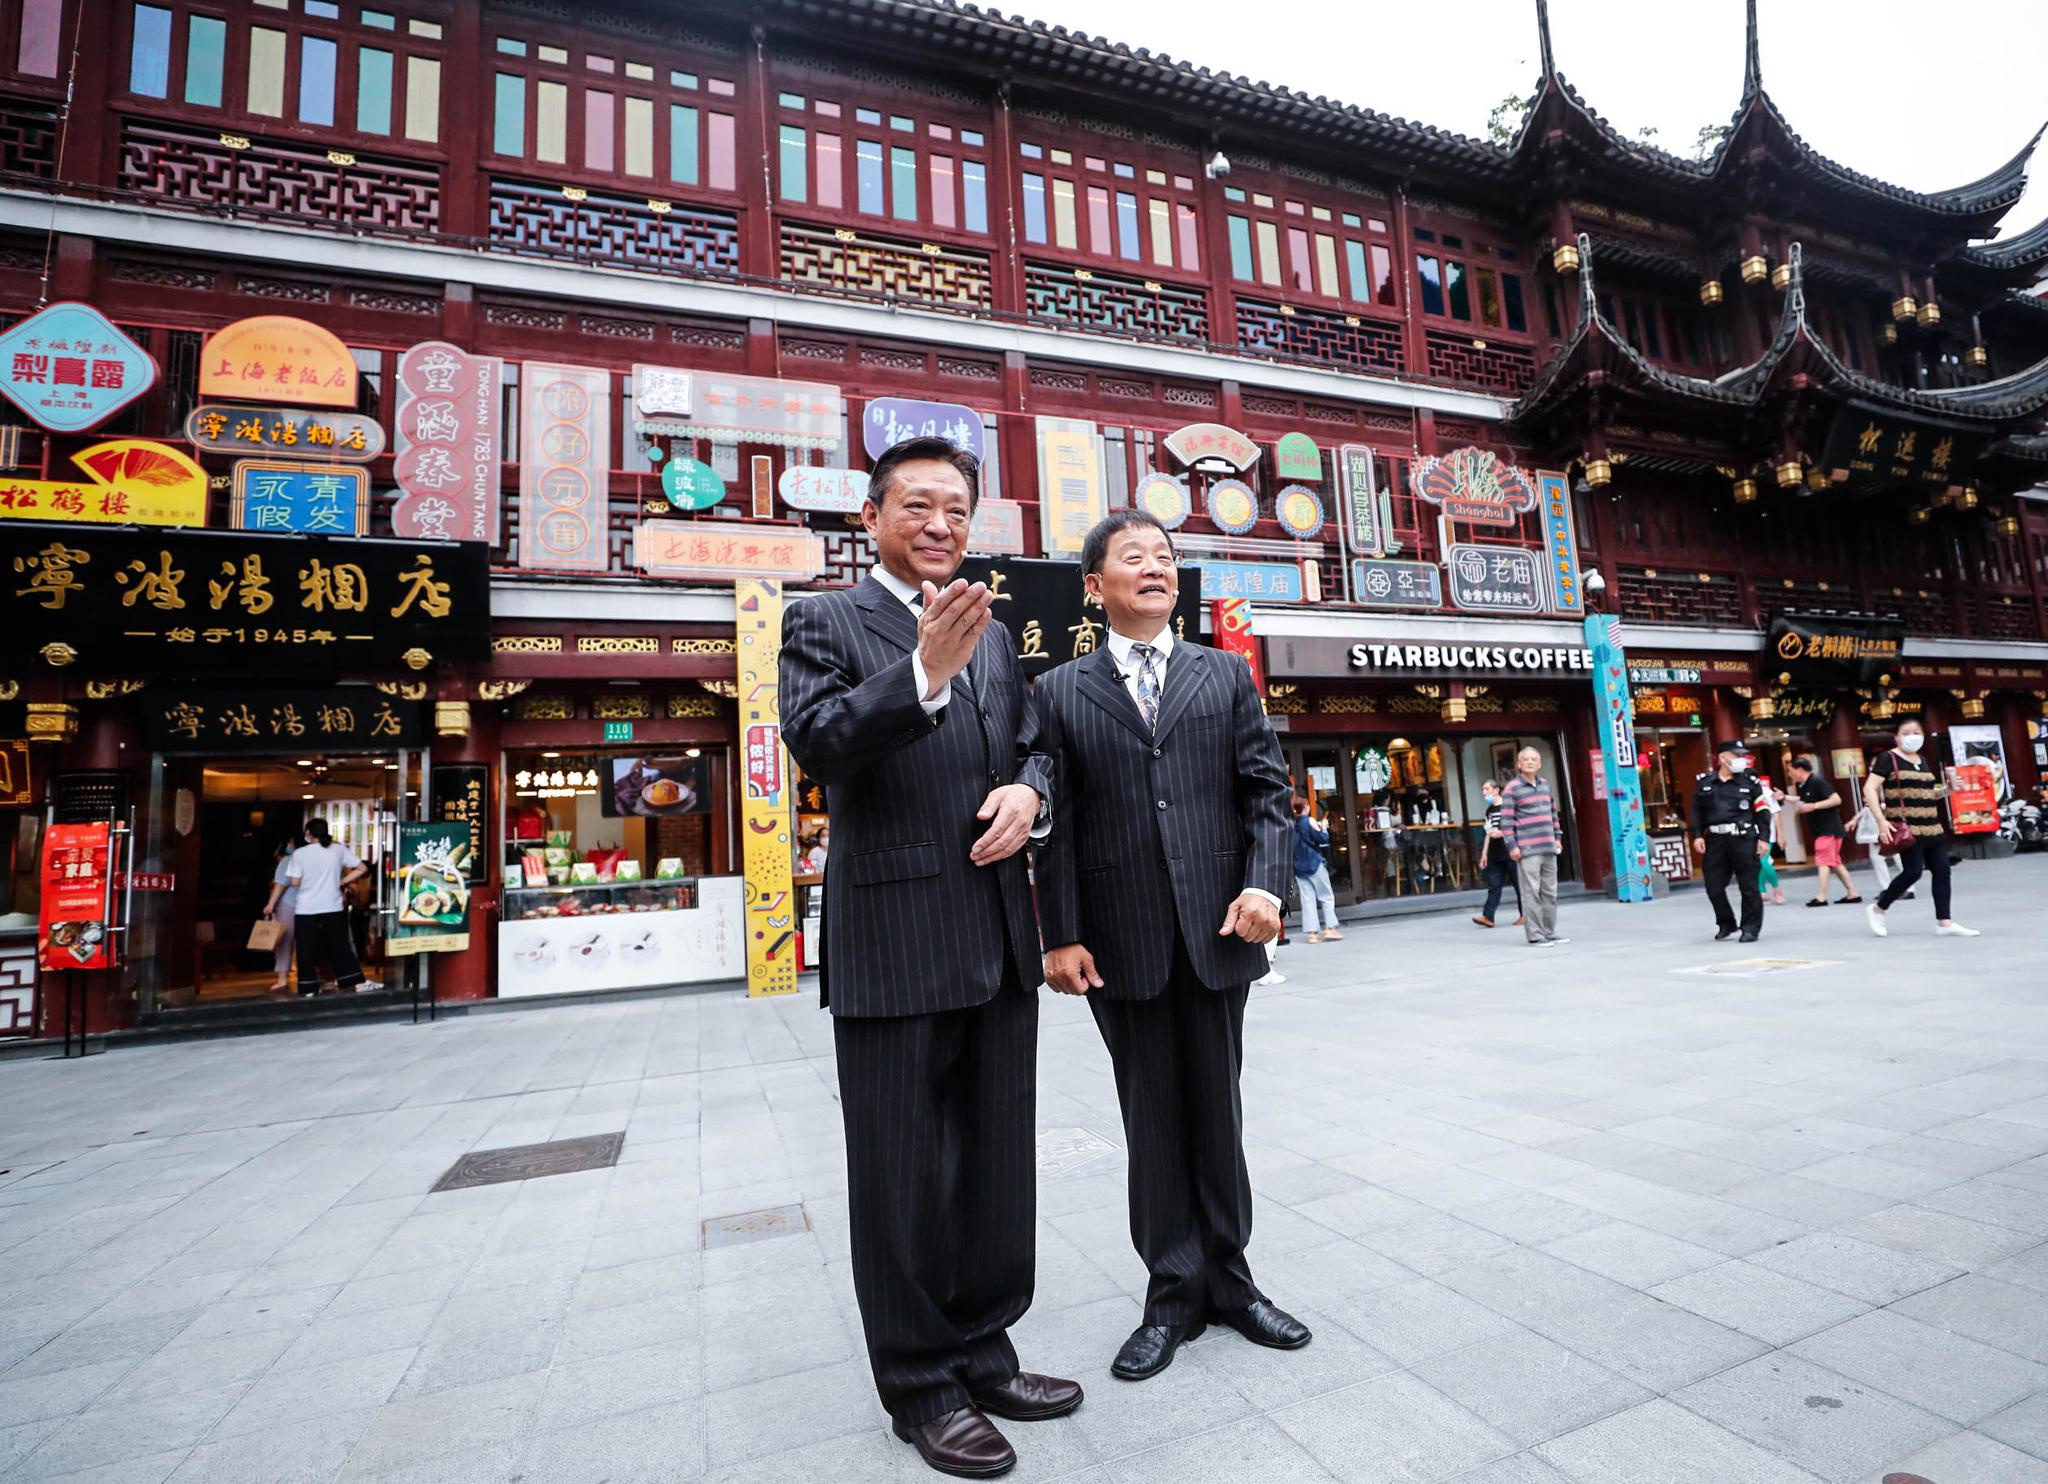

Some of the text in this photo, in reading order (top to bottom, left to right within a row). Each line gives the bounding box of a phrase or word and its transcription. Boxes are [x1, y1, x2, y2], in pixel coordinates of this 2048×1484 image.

[473, 363, 491, 538] TONG HAN 1783 CHUN TANG
[1454, 503, 1505, 519] Shanghai
[1491, 556, 1531, 585] 老庙
[165, 626, 338, 645] 始于1945年
[1352, 643, 1595, 670] STARBUCKS COFFEE
[608, 724, 628, 734] 110
